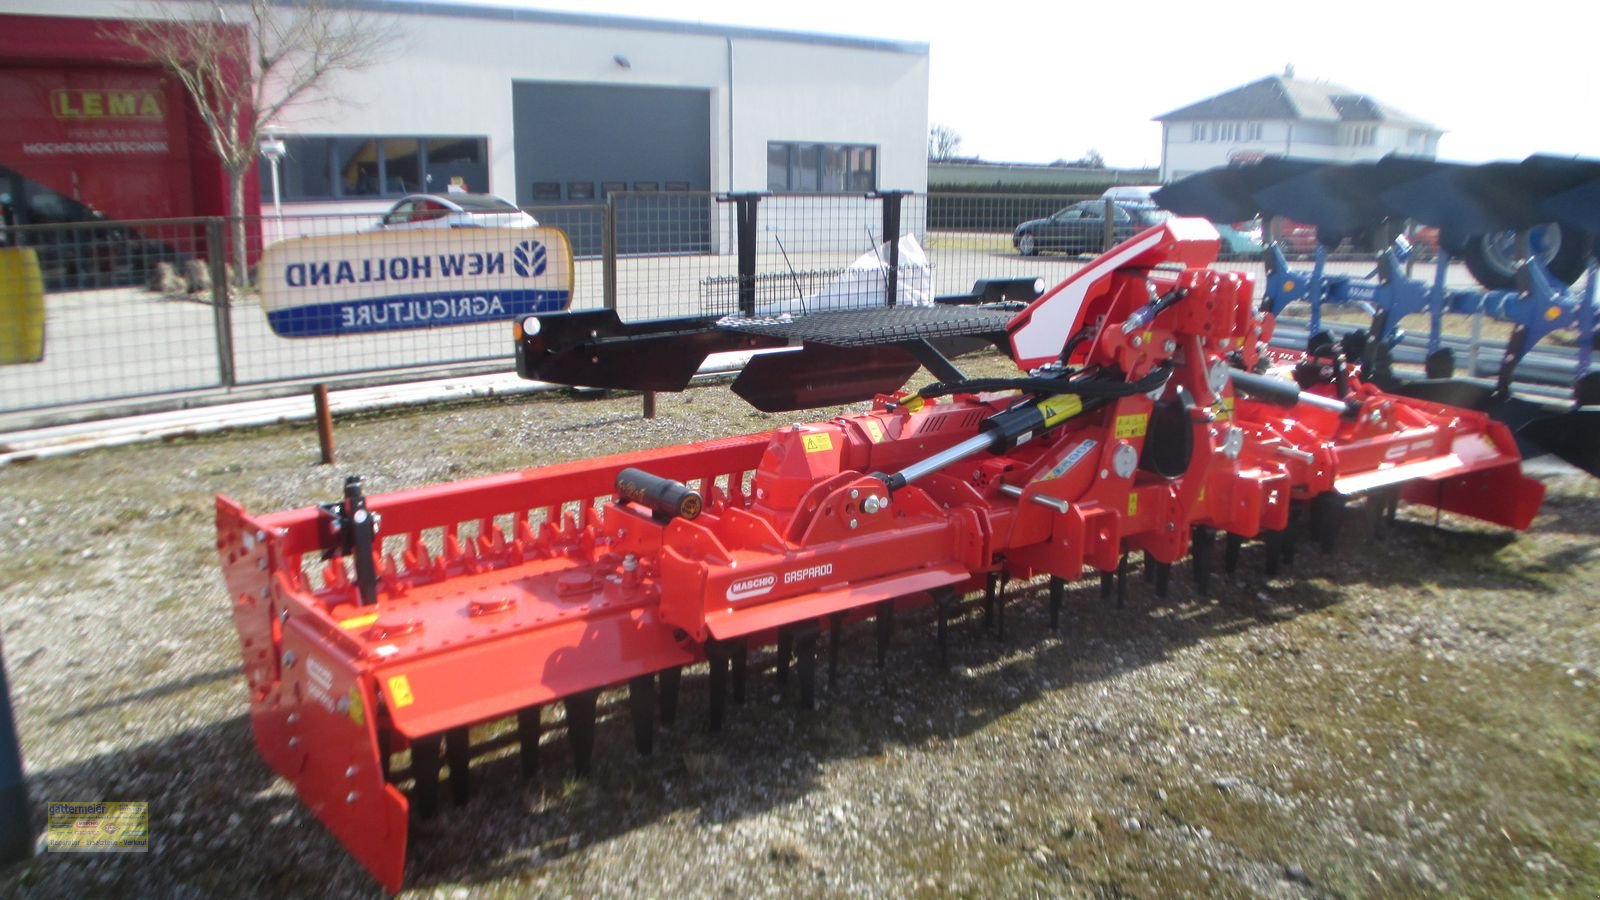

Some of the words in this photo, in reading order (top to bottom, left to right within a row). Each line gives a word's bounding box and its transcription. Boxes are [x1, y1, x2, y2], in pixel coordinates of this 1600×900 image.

[61, 94, 161, 115] LEMA
[732, 574, 775, 593] MASCHIO
[784, 563, 833, 585] GASPARDO
